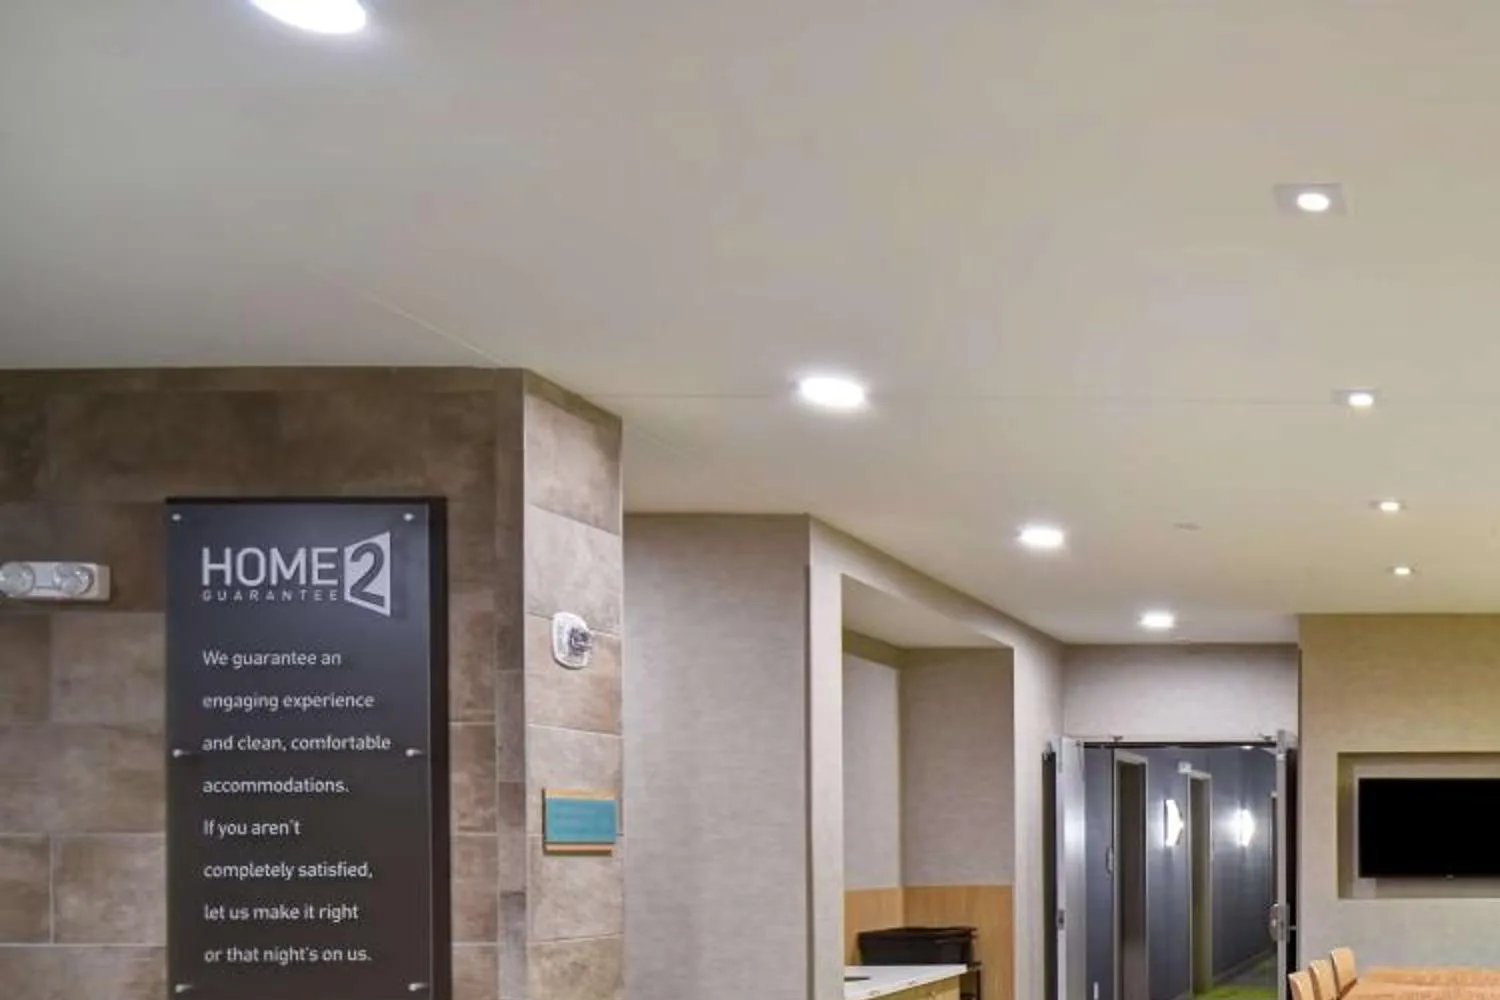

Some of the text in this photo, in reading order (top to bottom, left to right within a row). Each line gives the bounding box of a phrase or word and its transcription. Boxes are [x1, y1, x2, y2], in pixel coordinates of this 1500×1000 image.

[201, 546, 338, 587] HOME
[201, 589, 338, 602] GUARANTEE
[202, 651, 342, 670] We guarantee an
[202, 692, 376, 712] engaging experience
[202, 734, 392, 753] and clean, comfortable
[202, 777, 350, 794] accommodations.
[203, 819, 301, 839] If you aren't
[203, 861, 373, 881] completely satisfied,
[204, 904, 359, 923] let us make it right
[204, 946, 373, 966] or that night's on us.
